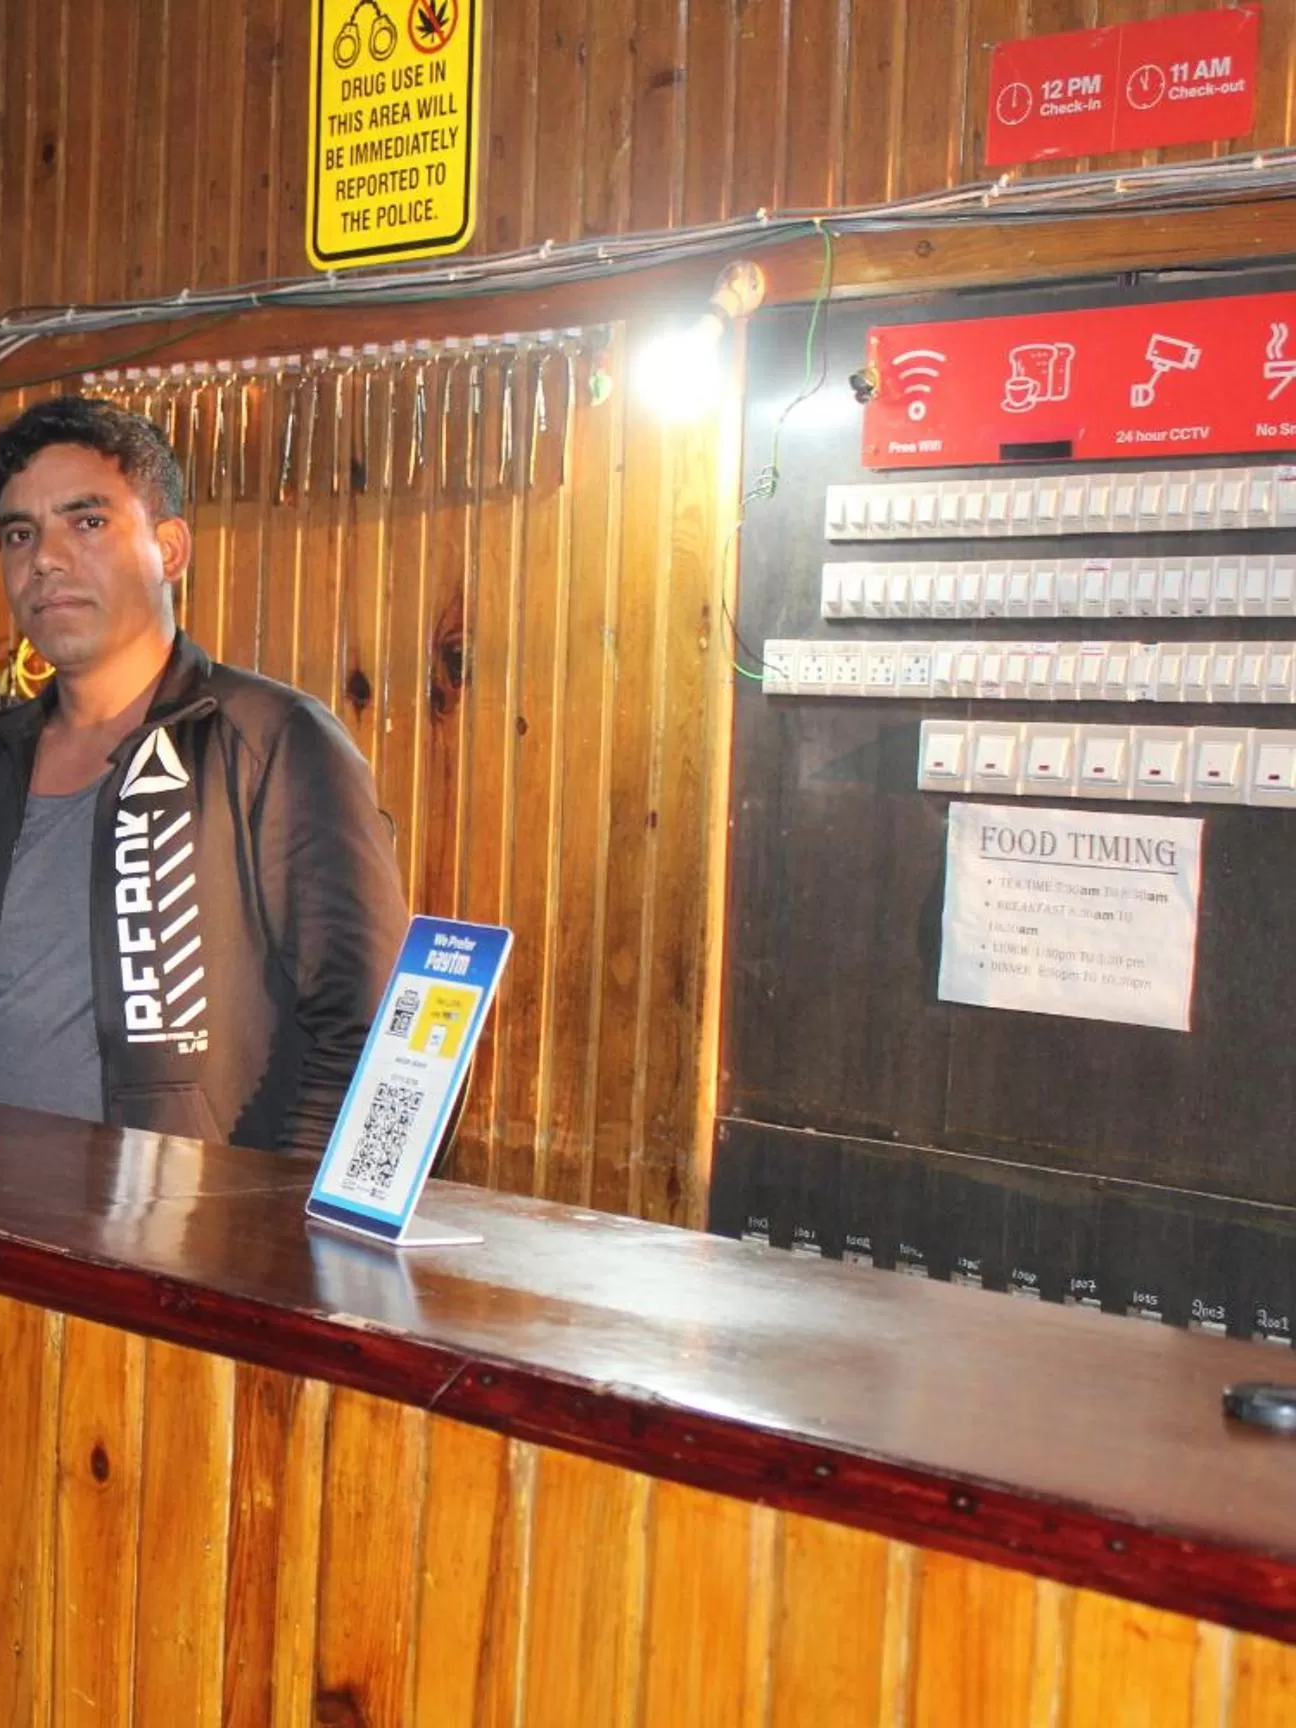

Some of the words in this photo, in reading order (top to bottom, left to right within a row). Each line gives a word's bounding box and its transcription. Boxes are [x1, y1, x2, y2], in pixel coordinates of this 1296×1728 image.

[341, 72, 386, 101] DRUG
[392, 64, 424, 92] USE
[430, 60, 446, 83] IN
[1169, 63, 1188, 82] 11
[1194, 56, 1231, 79] AM
[1041, 80, 1064, 100] 12
[1068, 75, 1101, 96] PM
[1168, 79, 1246, 101] Check-out
[328, 110, 363, 137] THIS
[369, 101, 411, 128] AREA
[417, 92, 458, 120] WILL
[1039, 98, 1101, 117] Check-in
[326, 145, 344, 170] BE
[350, 126, 459, 166] IMMEDIATELY
[336, 167, 419, 201] REPORTED
[426, 162, 447, 187] TO
[341, 210, 371, 233] THE
[376, 198, 438, 228] POLICE.
[1116, 430, 1132, 443] 24
[1136, 429, 1167, 442] hour
[1169, 426, 1211, 441] CCTV
[1256, 424, 1277, 437] No
[979, 826, 1058, 857] FOOD
[1067, 832, 1178, 867] TIMING
